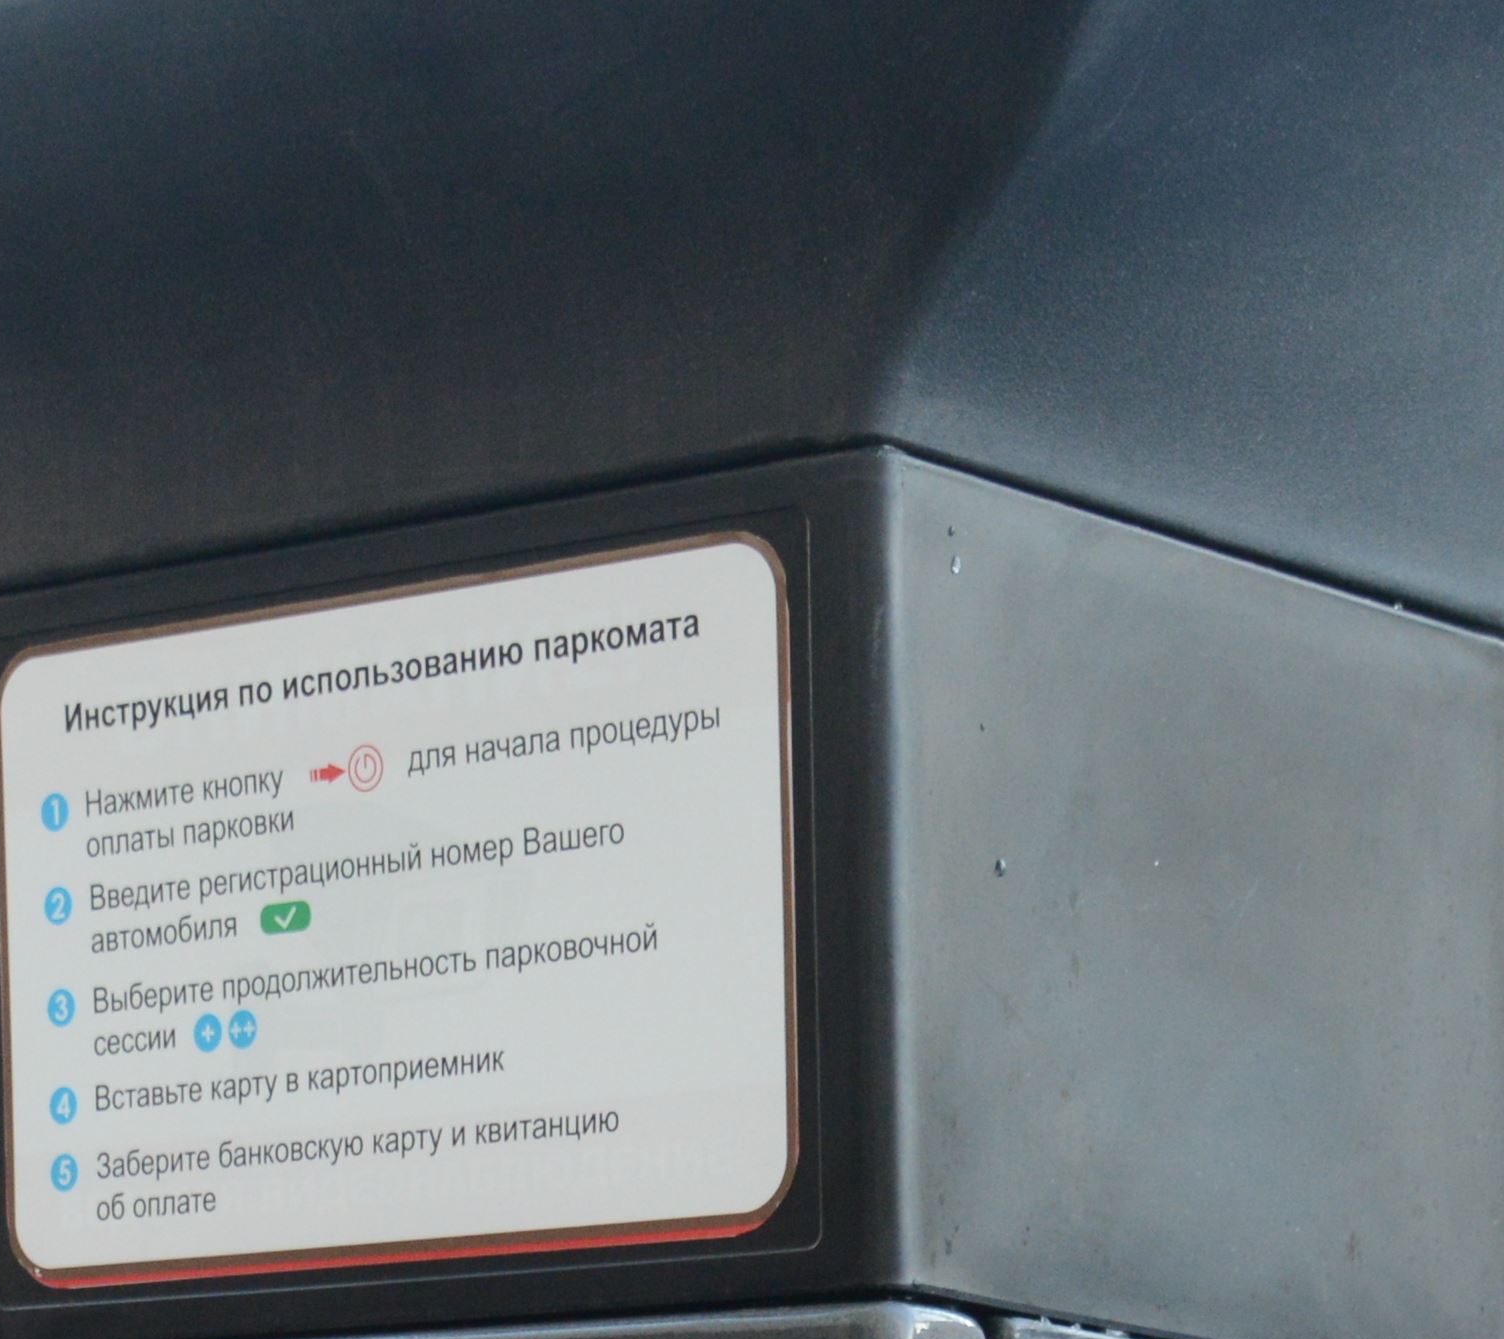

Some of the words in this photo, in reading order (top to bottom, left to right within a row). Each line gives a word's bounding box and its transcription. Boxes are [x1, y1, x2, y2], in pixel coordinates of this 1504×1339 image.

[64, 687, 229, 734] Инструкция
[238, 680, 273, 707] по
[282, 642, 524, 701] использованию
[534, 614, 700, 665] паркомата
[85, 782, 194, 817] Нажмите
[202, 770, 284, 801] кнопку
[407, 745, 456, 777] для
[465, 730, 561, 764] начала
[570, 706, 720, 755] процедуры
[86, 827, 175, 858] оплаты
[183, 810, 294, 848] парковки
[89, 879, 191, 911] Введите
[199, 842, 422, 905] регистрационный
[431, 837, 514, 868] номер
[523, 822, 625, 856] Вашего
[91, 914, 237, 954] автомобиля
[93, 981, 214, 1014] Выберите
[222, 951, 477, 1006] продолжительность
[485, 922, 658, 974] парковочной
[93, 1028, 176, 1057] сессии
[95, 1081, 203, 1112] Вставьте
[211, 1074, 278, 1105] карту
[286, 1072, 300, 1093] в
[308, 1050, 505, 1095] картоприемник
[96, 1148, 211, 1181] Заберите
[218, 1135, 364, 1169] банковскую
[372, 1127, 443, 1159] карту
[451, 1125, 466, 1147] и
[475, 1110, 620, 1145] квитанцию
[96, 1192, 125, 1222] об
[132, 1191, 217, 1218] оплате
